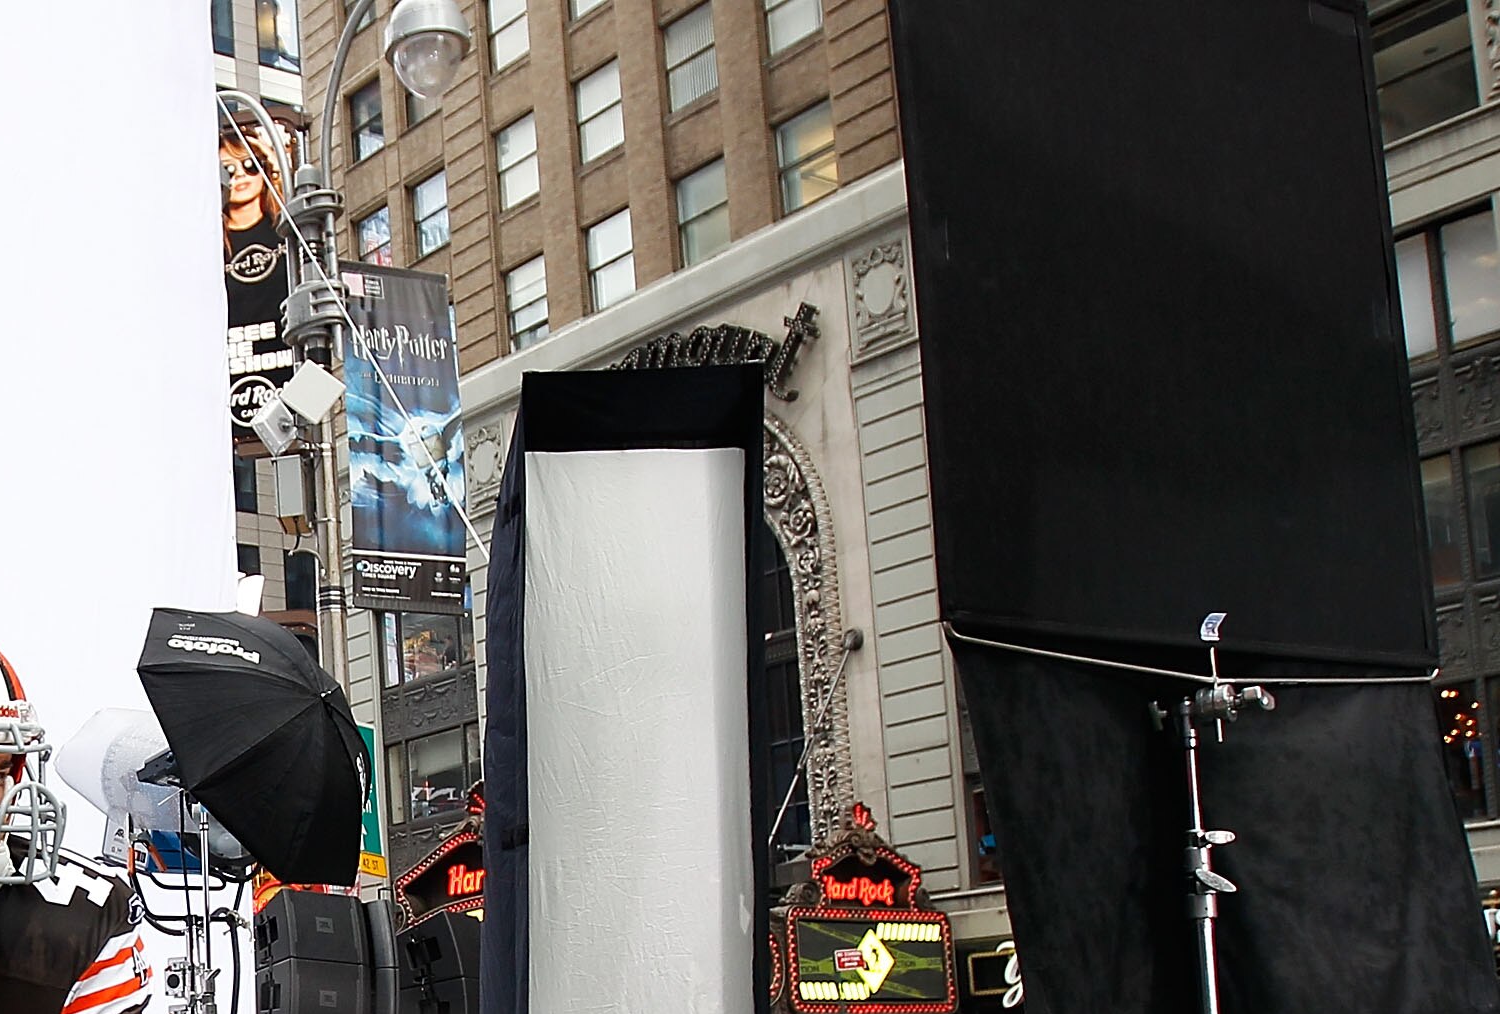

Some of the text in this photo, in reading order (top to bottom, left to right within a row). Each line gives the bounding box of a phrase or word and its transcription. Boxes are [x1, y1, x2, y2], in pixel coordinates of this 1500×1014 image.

[225, 242, 288, 272] ard Rock
[228, 321, 276, 343] SEE
[227, 341, 253, 358] HE
[352, 324, 448, 371] Harry Potter
[229, 349, 293, 376] SHOW
[374, 370, 440, 387] EHIBITION
[231, 381, 290, 408] rd Roc
[240, 408, 261, 419] CAF
[167, 637, 261, 665] Profoto
[371, 859, 380, 871] ST
[448, 863, 486, 896] Har
[823, 875, 895, 907] Hard Rock
